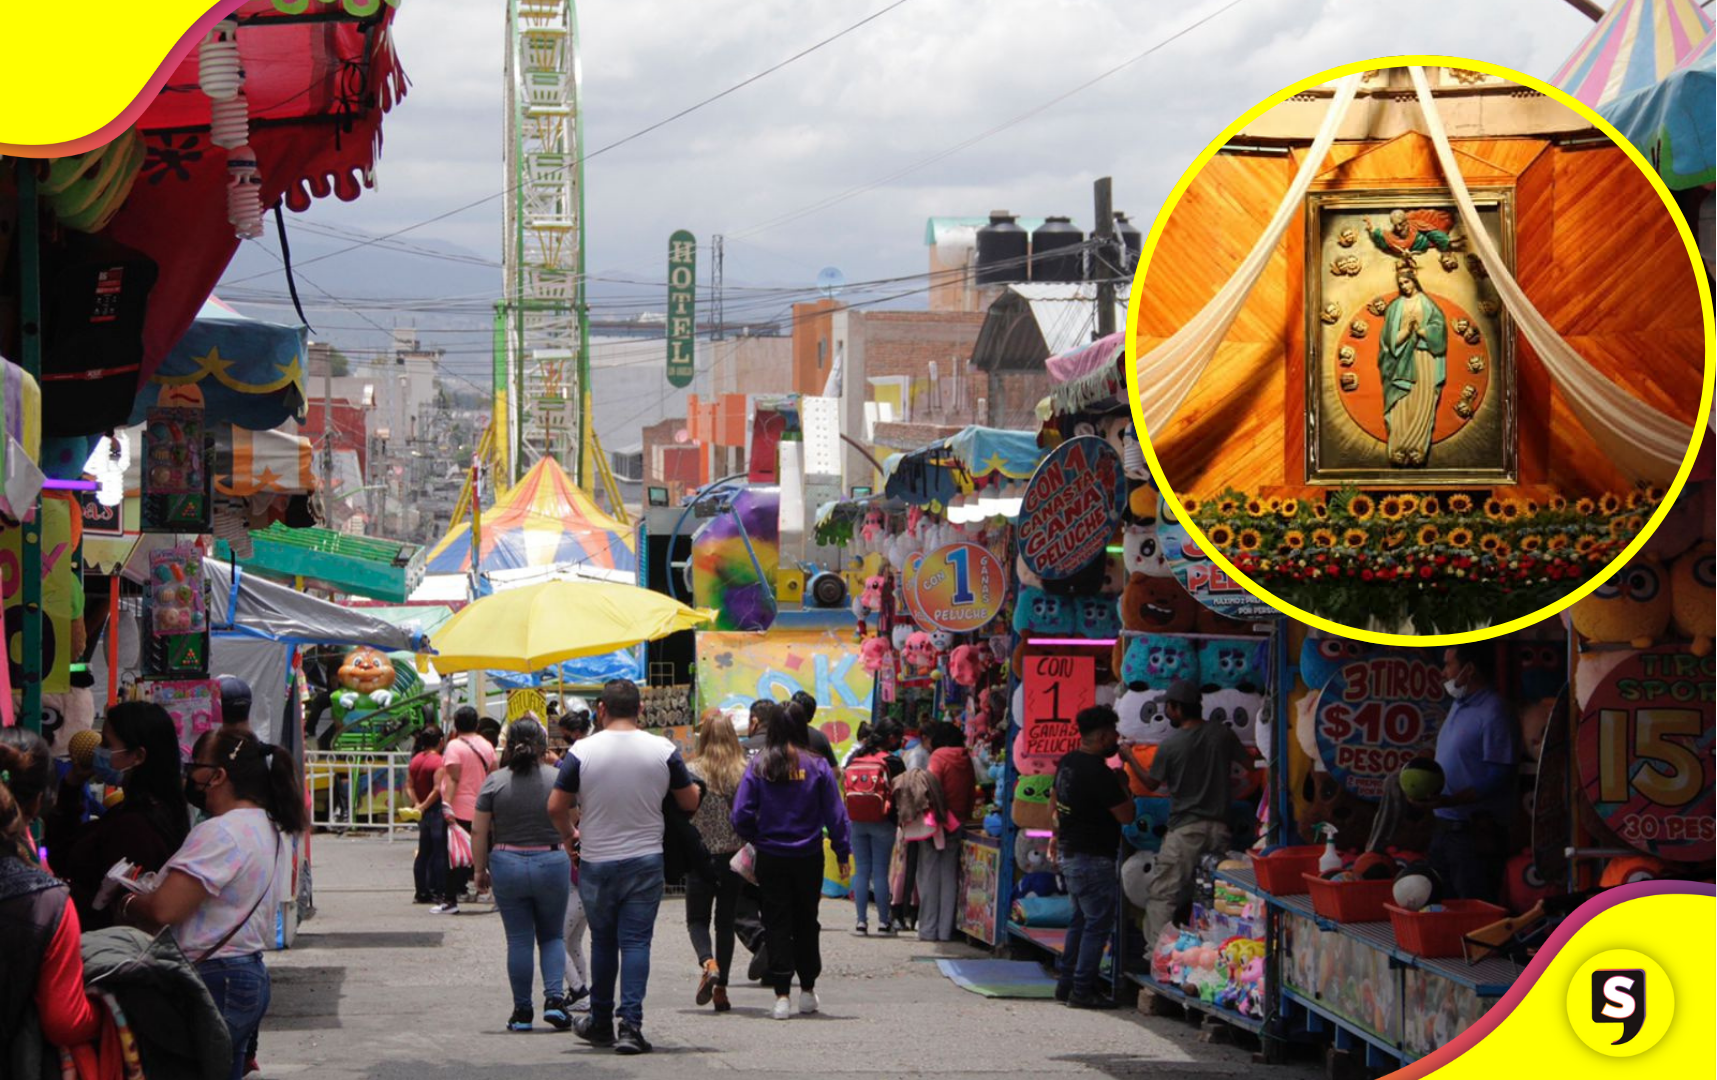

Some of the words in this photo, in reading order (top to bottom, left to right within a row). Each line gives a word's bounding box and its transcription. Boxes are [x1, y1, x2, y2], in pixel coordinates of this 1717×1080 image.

[671, 240, 693, 365] HOTEL
[1024, 460, 1065, 513] CON
[1063, 441, 1088, 476] 1
[1019, 469, 1095, 540] CANASTA
[1026, 484, 1104, 558] GANA
[1035, 506, 1107, 573] PELUCHE
[923, 570, 946, 591] CON
[946, 546, 976, 605] 1
[979, 555, 990, 604] GANAS
[933, 608, 988, 621] PELUCHE
[1238, 606, 1252, 615] POR
[1036, 657, 1075, 679] CON
[1034, 681, 1071, 724] 1
[1319, 701, 1424, 746] $10
[1029, 723, 1079, 740] GANAS
[1598, 706, 1706, 807] 15
[1355, 776, 1384, 789] PREMIO
[1623, 812, 1660, 840] 30
